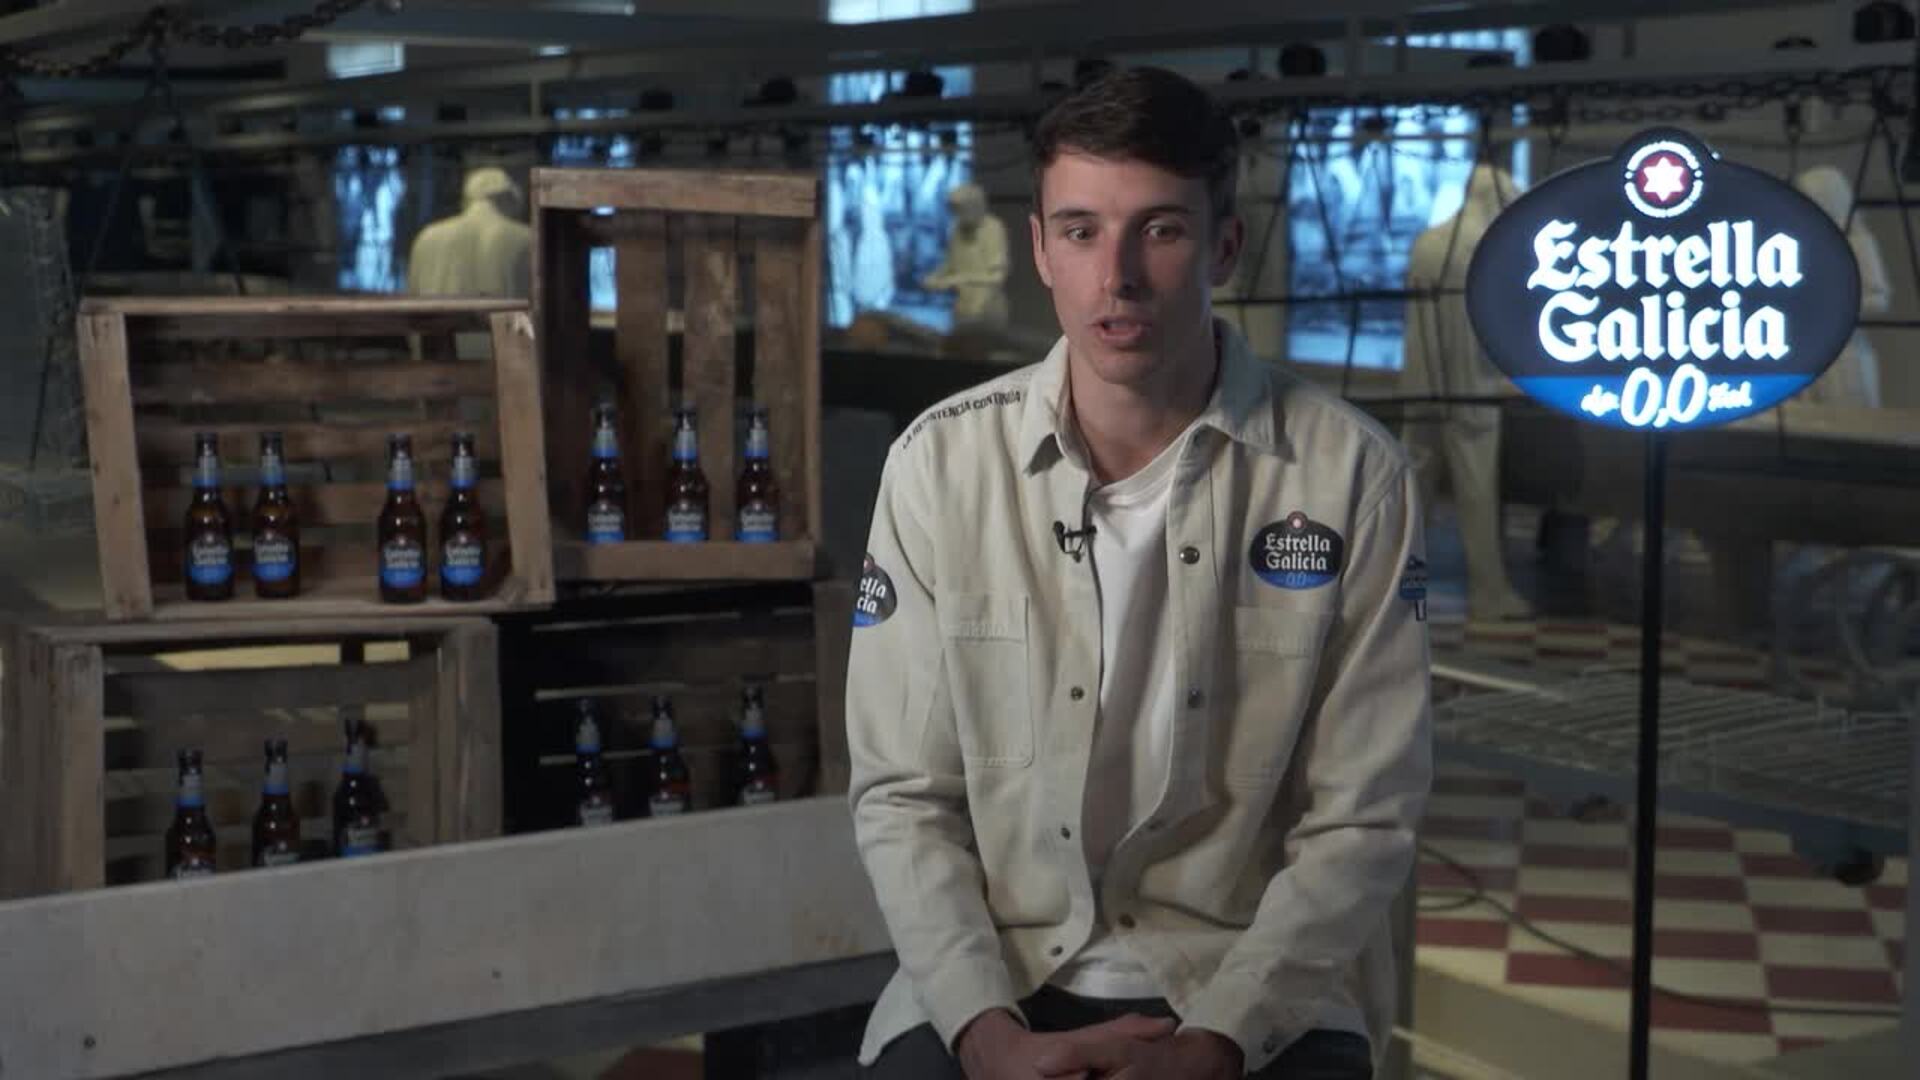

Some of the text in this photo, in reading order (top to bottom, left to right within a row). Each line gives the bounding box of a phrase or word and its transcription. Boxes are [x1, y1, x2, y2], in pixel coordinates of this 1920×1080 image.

[1527, 219, 1803, 291] Estrella
[1538, 290, 1791, 362] Galicia
[1620, 363, 1708, 428] 0,0
[1265, 533, 1331, 553] Estrella
[1266, 552, 1328, 571] Galicia
